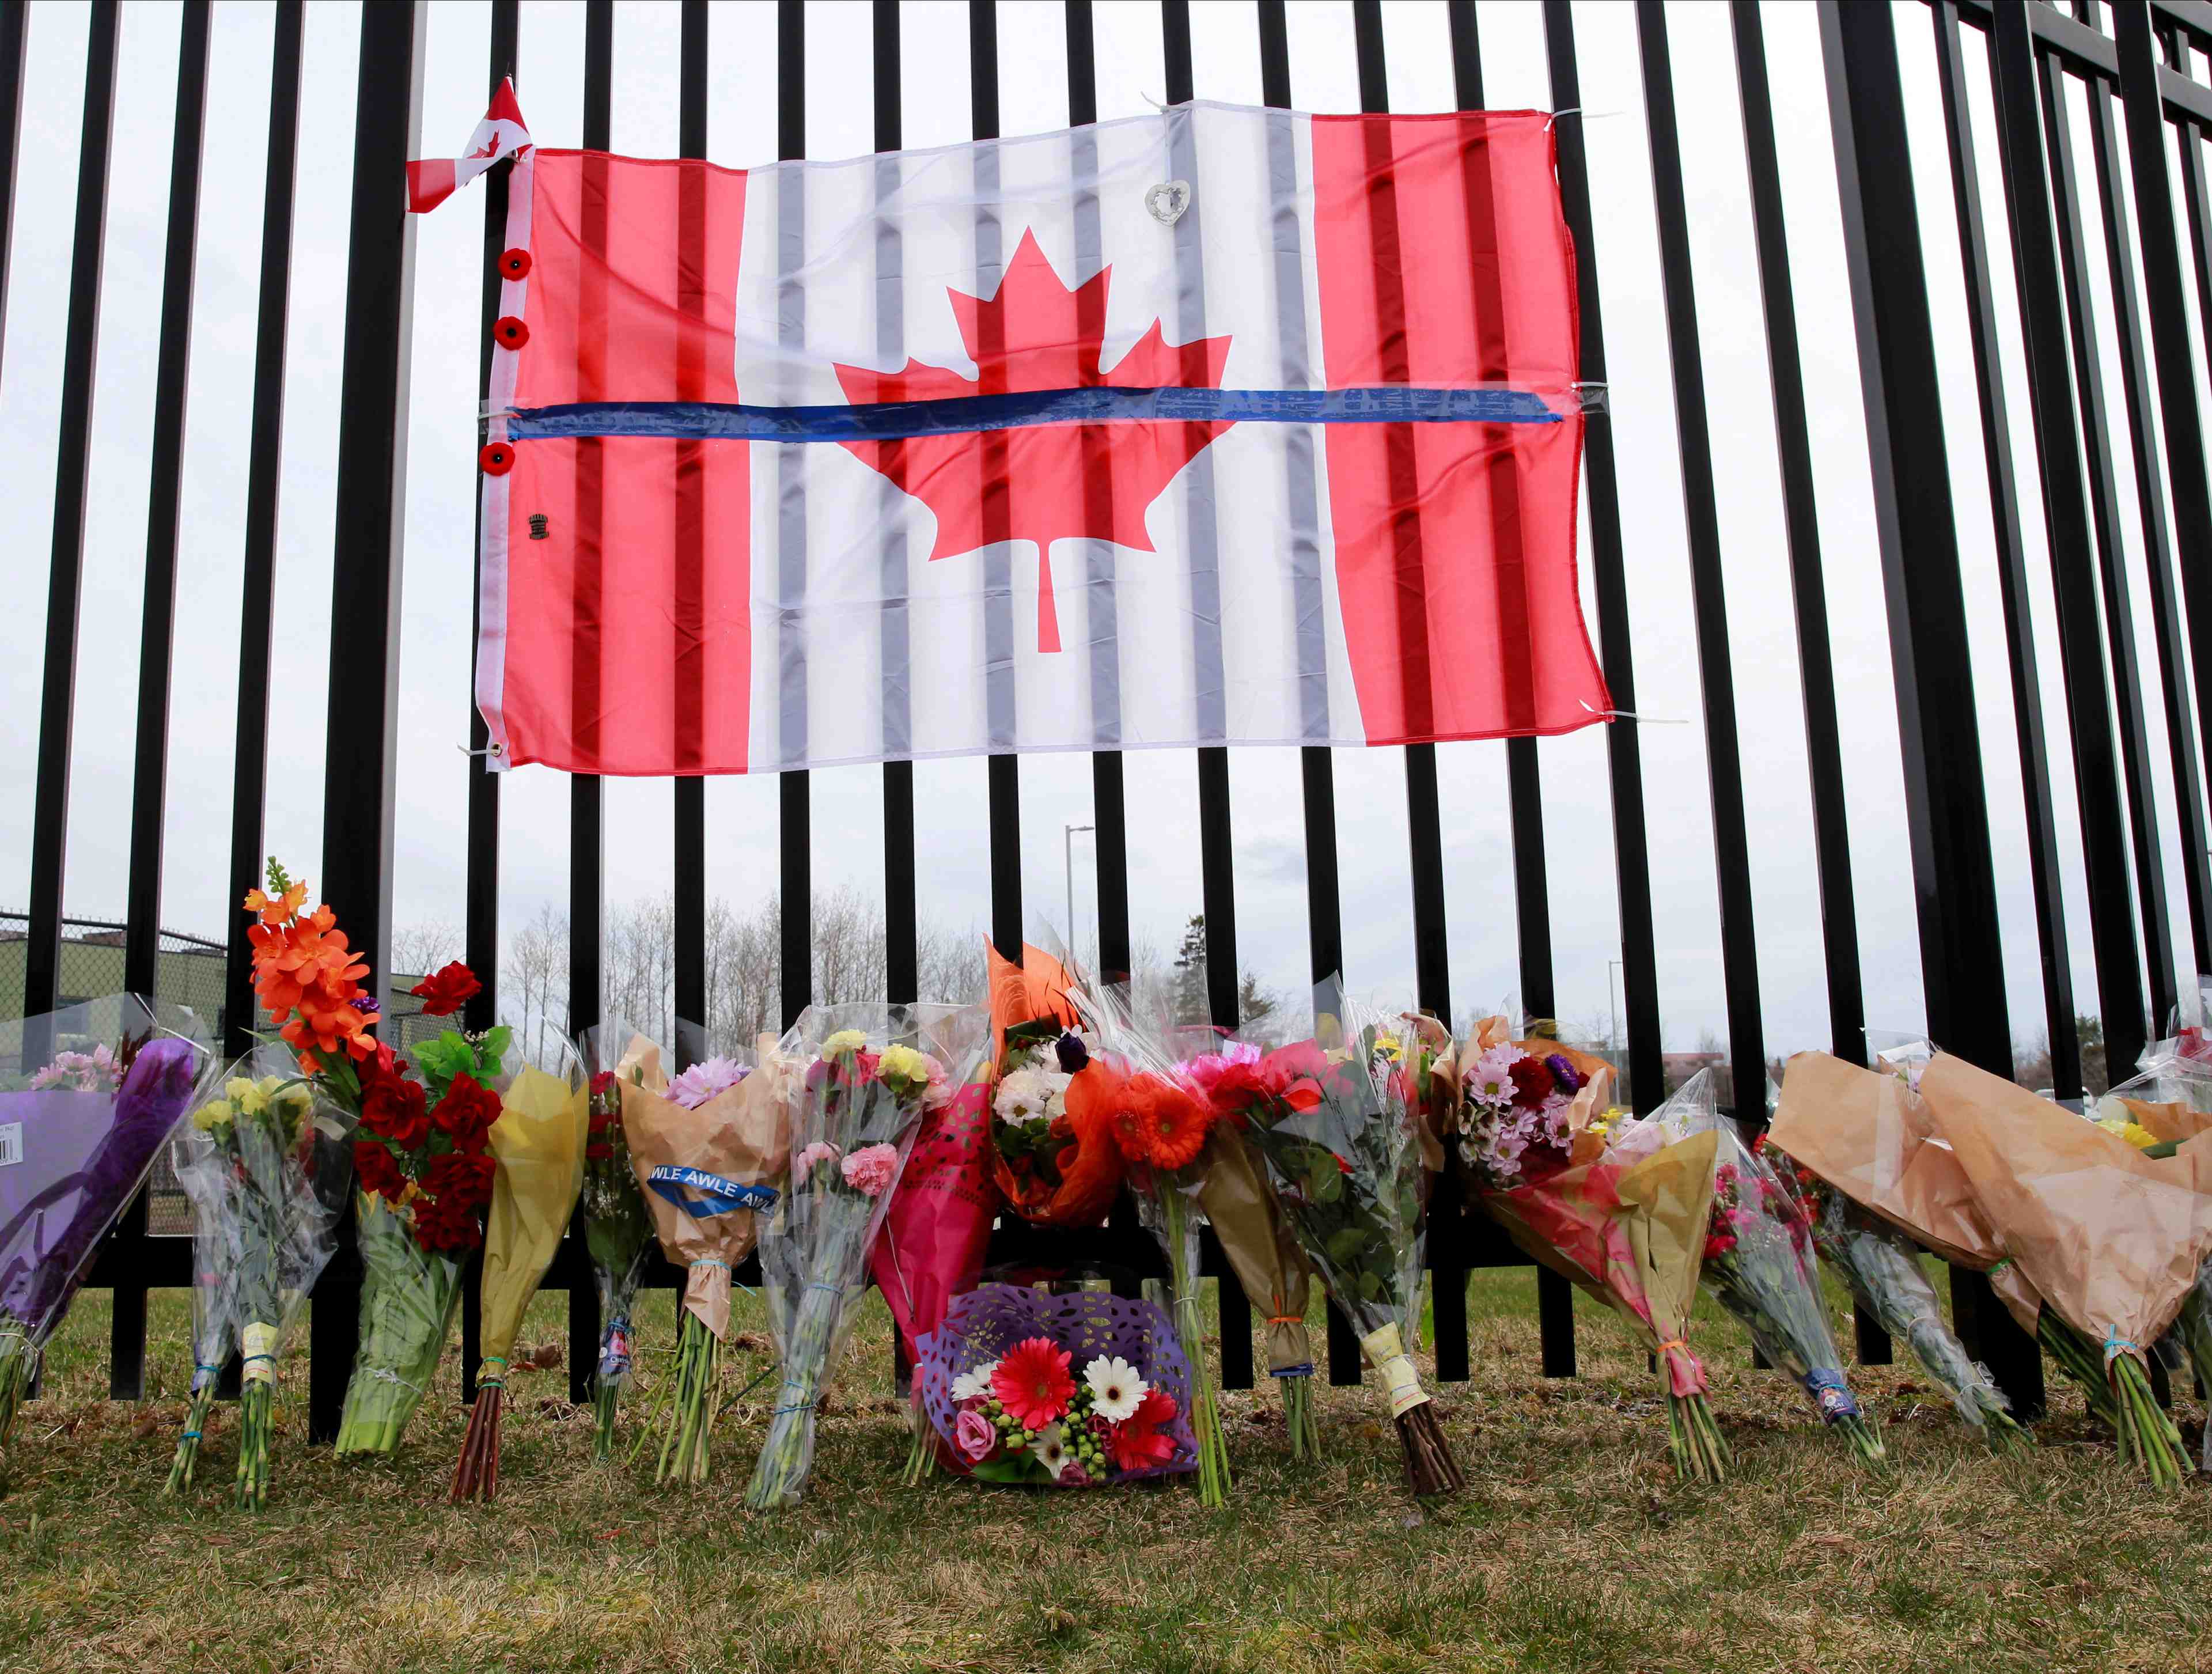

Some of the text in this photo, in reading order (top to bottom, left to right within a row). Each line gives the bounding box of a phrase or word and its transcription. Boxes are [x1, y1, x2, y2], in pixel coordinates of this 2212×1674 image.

[649, 1167, 770, 1213] WLE AWLE AWL
